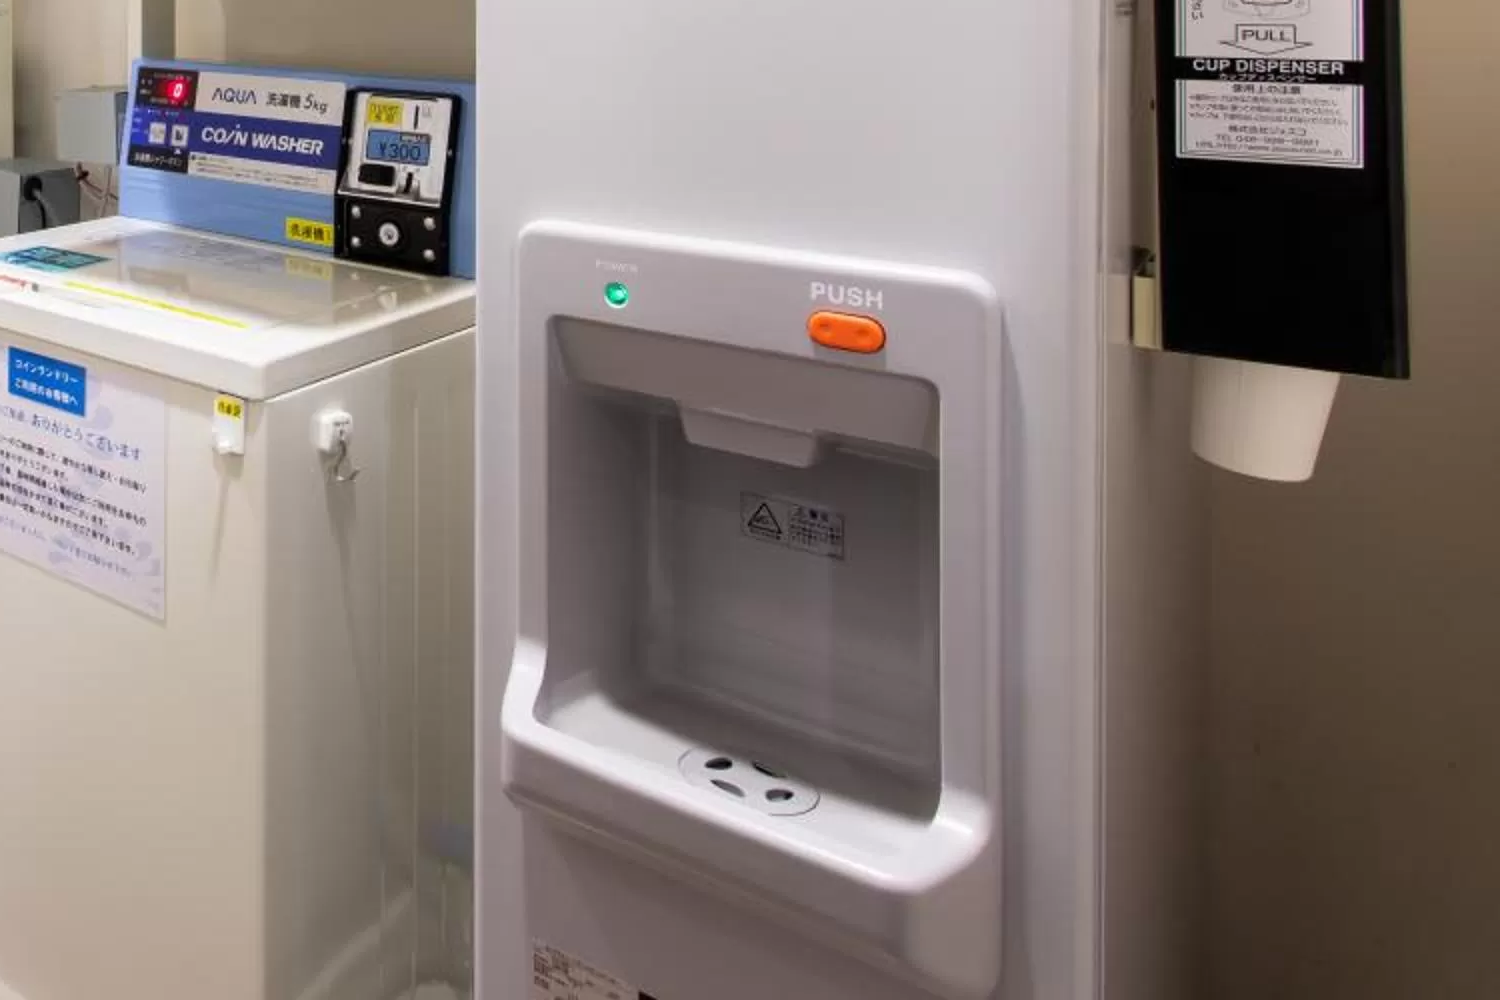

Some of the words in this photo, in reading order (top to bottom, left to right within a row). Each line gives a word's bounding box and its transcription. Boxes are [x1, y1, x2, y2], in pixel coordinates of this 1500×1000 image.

[1240, 28, 1293, 43] PULL
[1192, 58, 1231, 72] CUP
[1235, 59, 1345, 75] DISPENSER
[211, 88, 258, 105] AQUA
[266, 91, 301, 108] 洗濯機
[303, 90, 329, 115] 5kg
[201, 123, 249, 148] COIN
[251, 129, 325, 157] WASHER
[809, 281, 884, 310] PUSH
